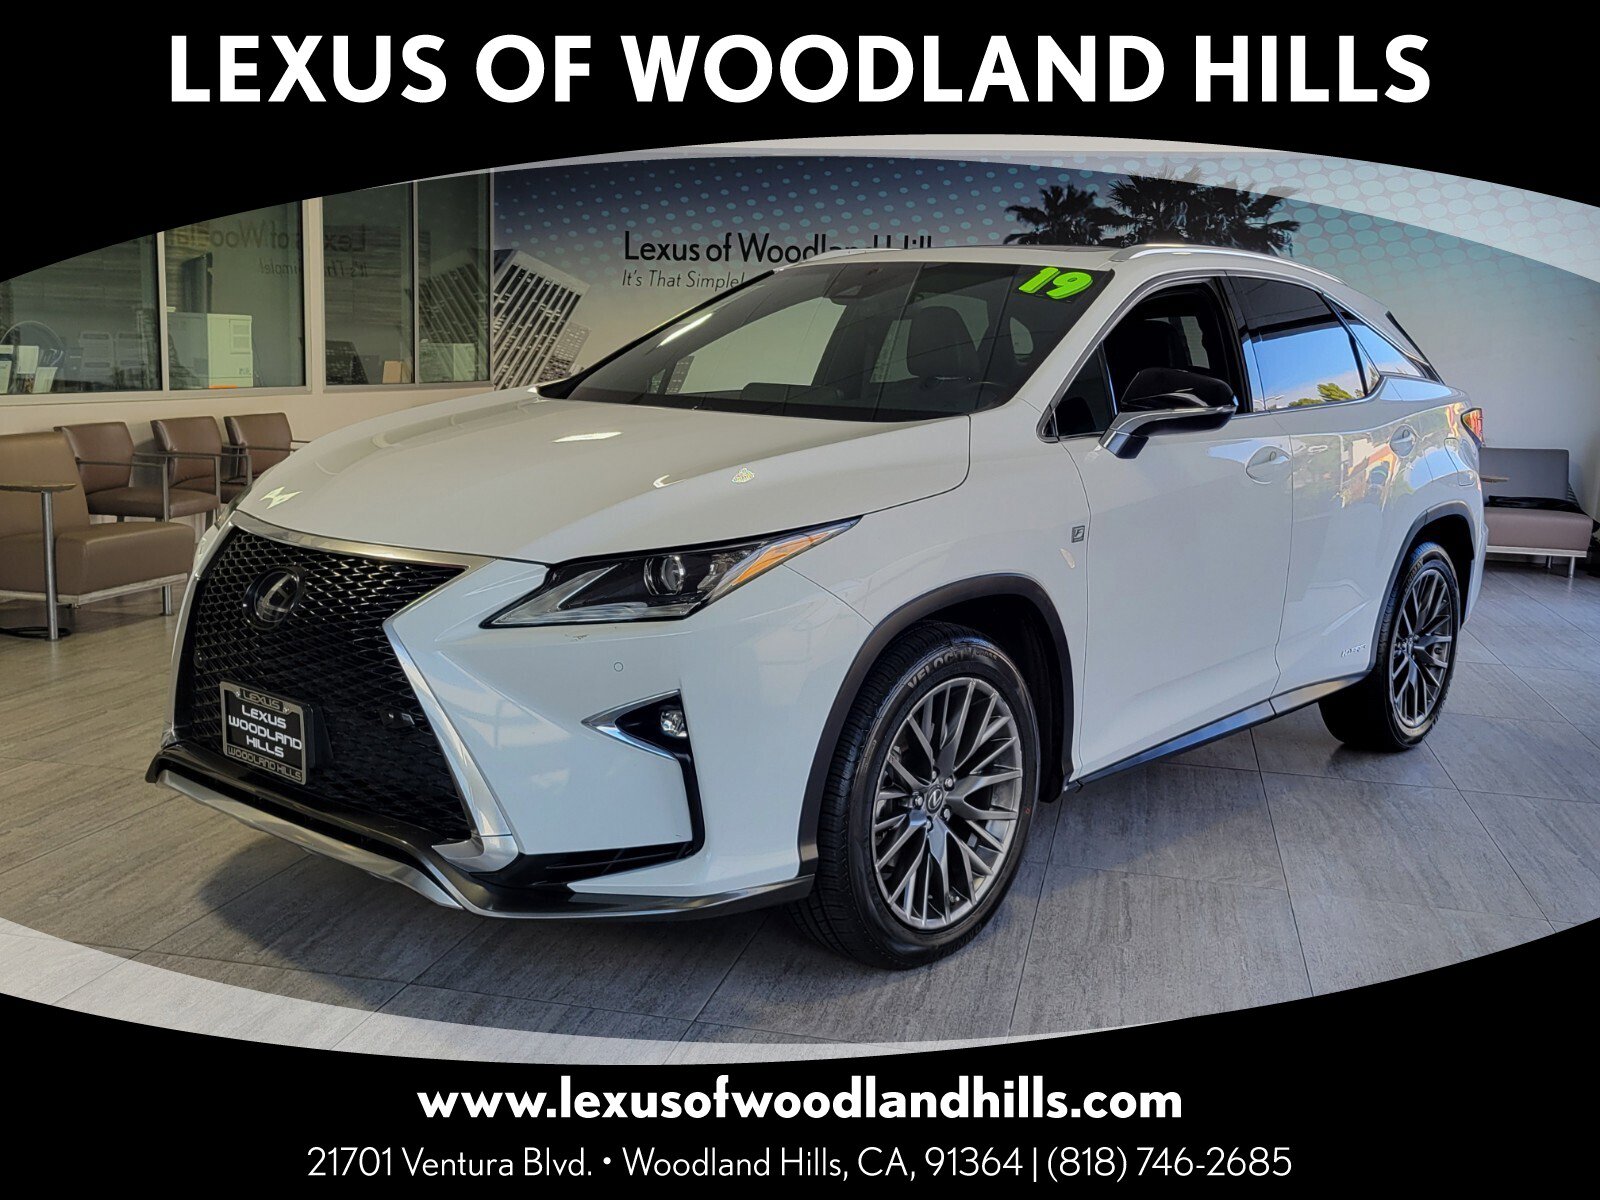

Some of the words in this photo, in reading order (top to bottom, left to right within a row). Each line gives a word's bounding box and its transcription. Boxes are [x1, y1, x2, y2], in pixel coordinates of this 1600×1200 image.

[624, 230, 700, 262] Lexus
[706, 232, 732, 262] of
[622, 269, 643, 287] It's
[649, 269, 682, 288] That
[686, 270, 745, 292] Simple!
[1018, 266, 1094, 300] 19
[243, 690, 280, 710] LEXUS
[241, 704, 287, 729] LEXUS
[228, 715, 303, 750] WOODLAND
[246, 735, 285, 758] HILLS
[227, 746, 277, 771] WOODLAND
[277, 764, 302, 781] HILLS
